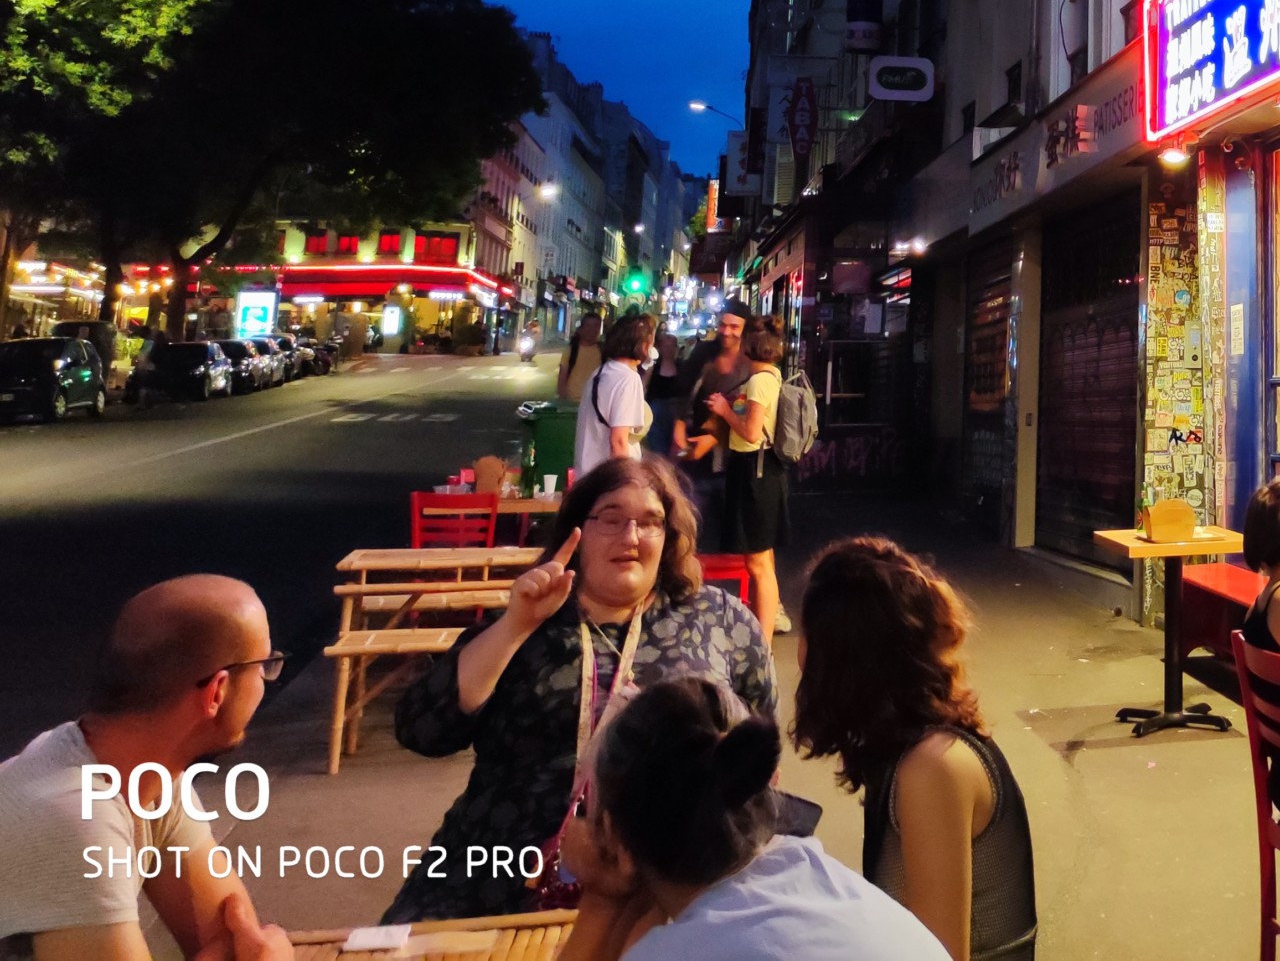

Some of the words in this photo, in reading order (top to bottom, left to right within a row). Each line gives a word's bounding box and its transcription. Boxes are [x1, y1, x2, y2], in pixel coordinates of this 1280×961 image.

[795, 82, 811, 155] TABAC
[1094, 79, 1146, 140] PATISSERIE
[1150, 265, 1160, 284] BNE
